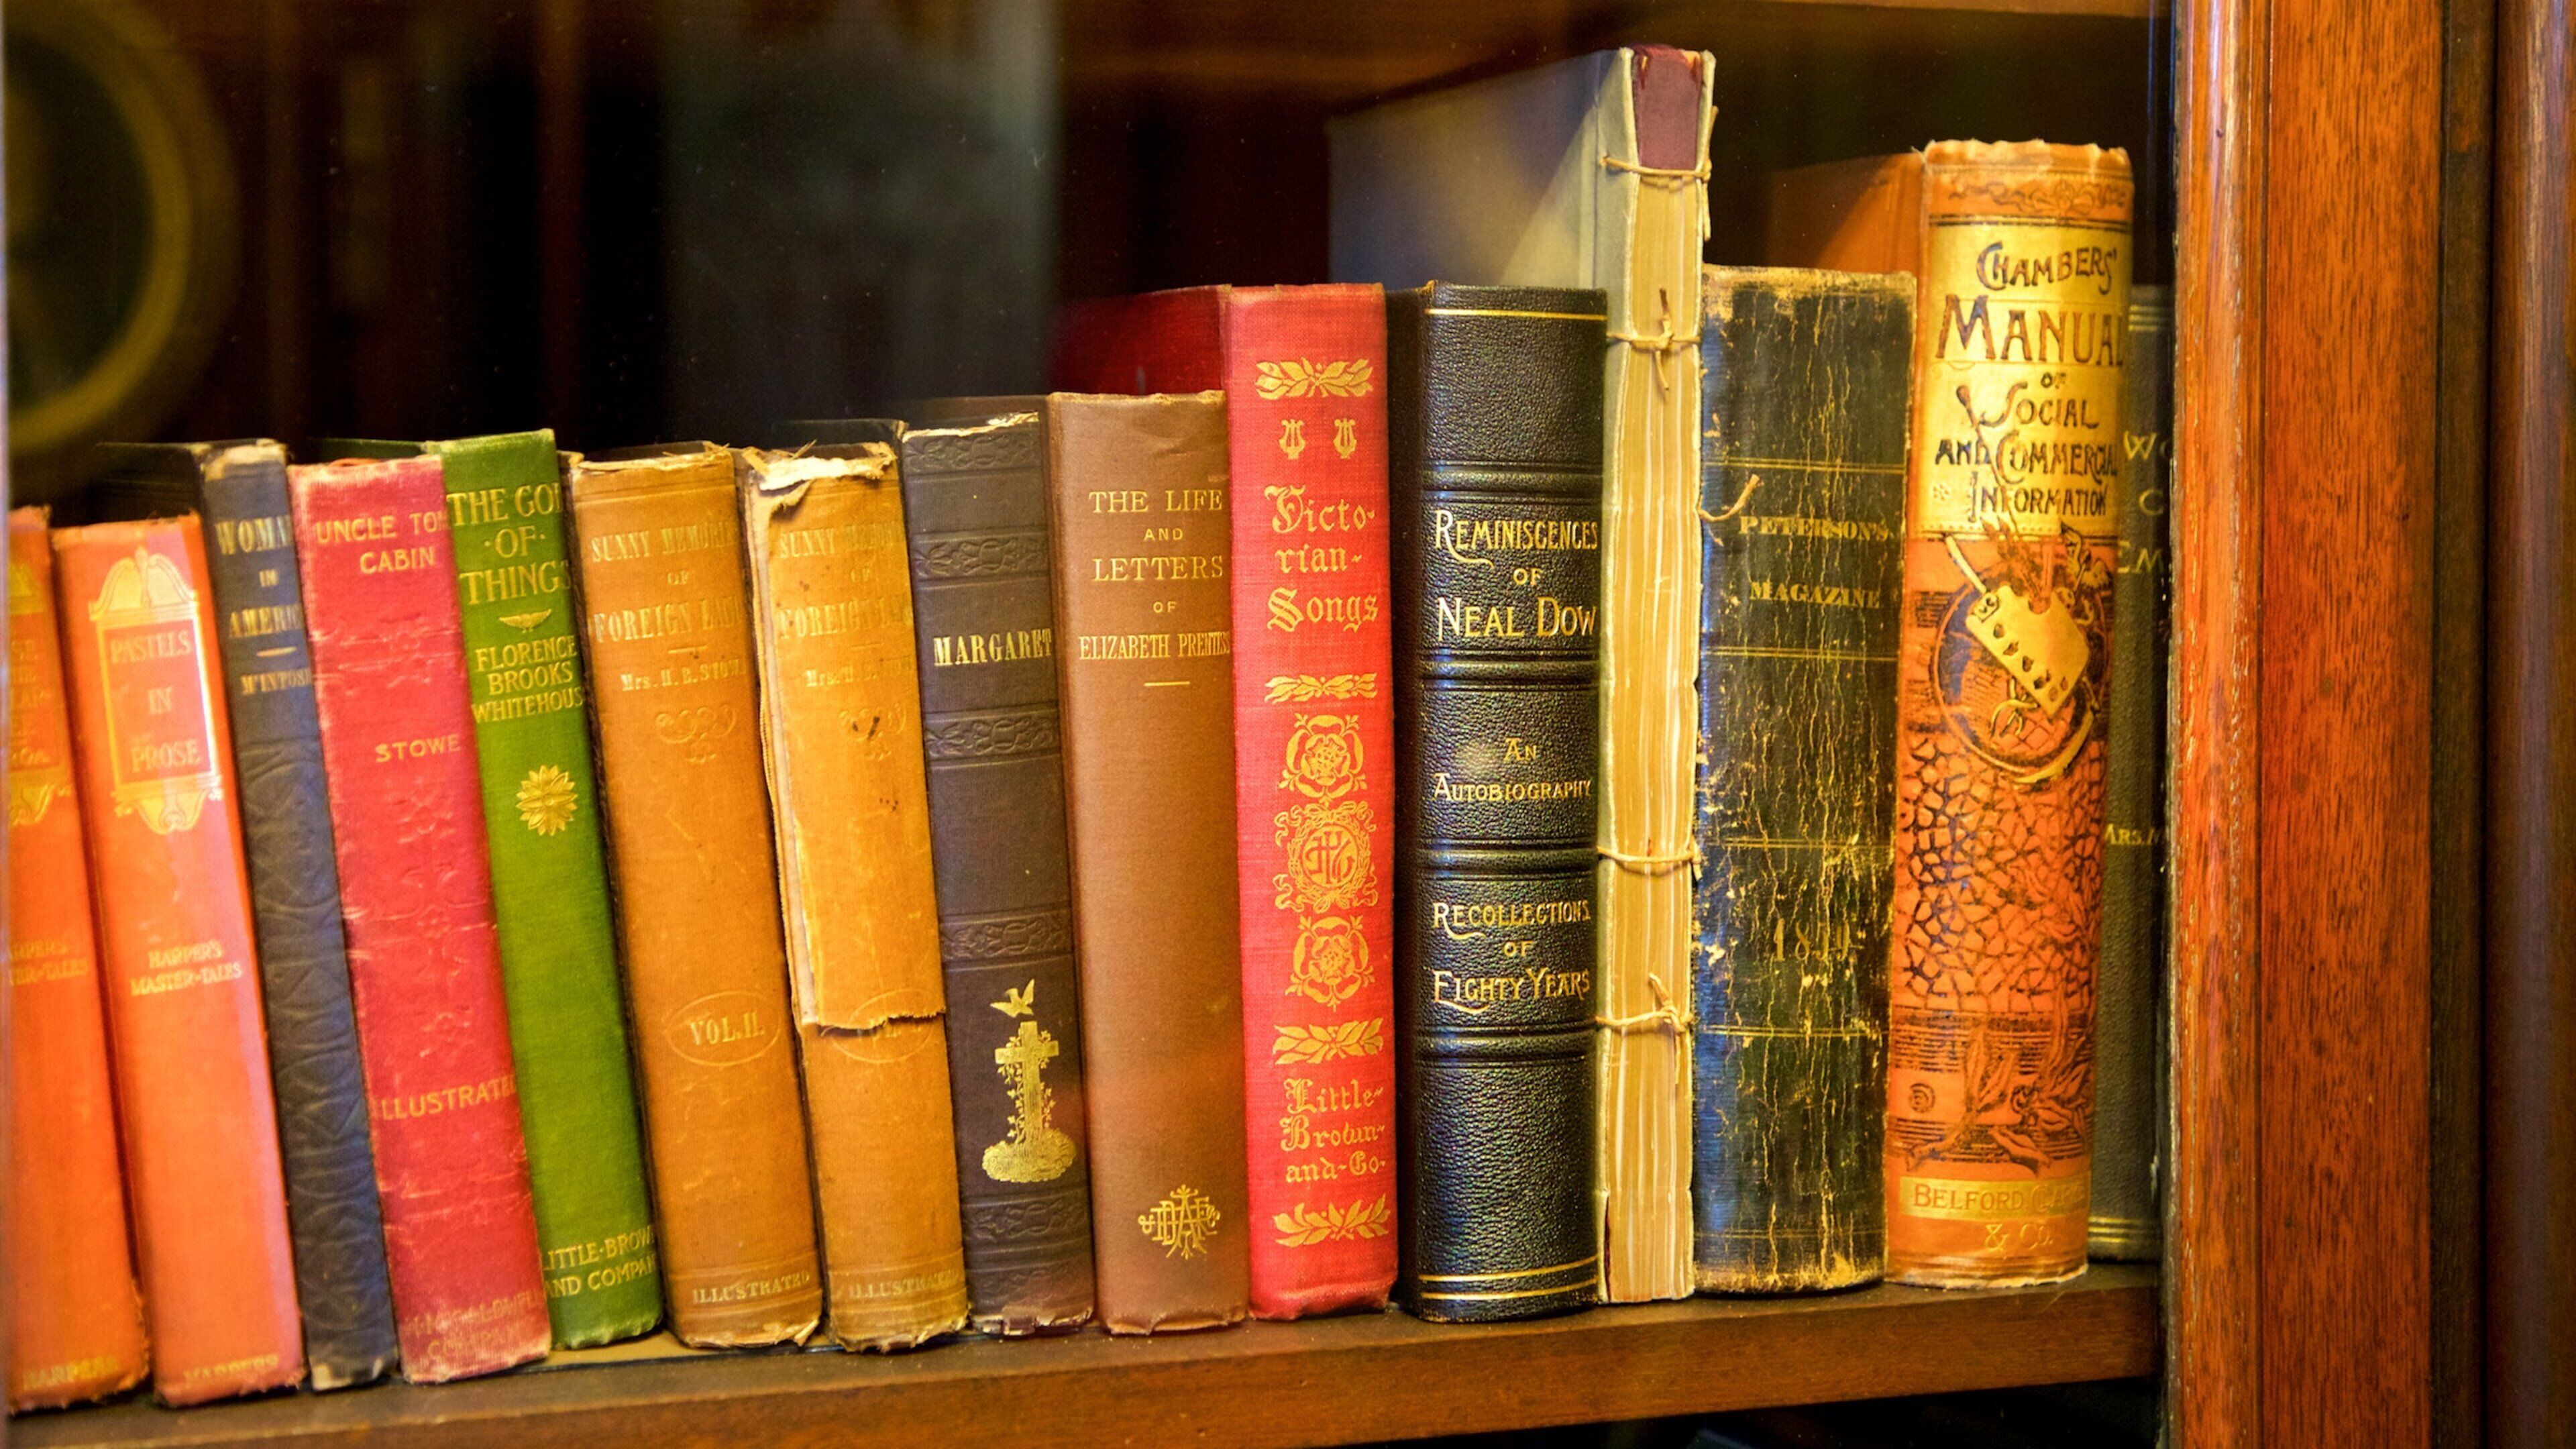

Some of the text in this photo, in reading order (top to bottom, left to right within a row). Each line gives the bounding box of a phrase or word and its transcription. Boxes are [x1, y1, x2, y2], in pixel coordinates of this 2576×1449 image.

[1976, 241, 2117, 295] CHAMBERS'
[1935, 294, 2124, 367] MANUAL
[2041, 372, 2066, 388] OF
[1978, 382, 2100, 429] SOCIAL
[1935, 439, 1991, 466] AND
[1996, 430, 2118, 484] COMMERCIAL
[446, 488, 508, 527] THE
[1088, 489, 1223, 514] THE LIFE
[1968, 472, 2108, 523] INFORMATION
[316, 515, 396, 544] UNCLE
[1143, 527, 1183, 542] AND
[1434, 508, 1599, 568] REMINISCENCES
[1739, 516, 1889, 541] PETERSON'S
[360, 546, 435, 574] CABIN
[591, 531, 651, 562] SUNNY
[667, 570, 690, 585] OF
[1093, 555, 1224, 582] LETTERS
[1513, 568, 1544, 586] OF
[1153, 601, 1177, 613] OF
[1267, 587, 1379, 633] Songs
[1750, 582, 1880, 608] MAGAZINE
[594, 602, 692, 643] FOREIGN
[1437, 596, 1597, 641] NEAL DOW
[110, 631, 191, 665] PASTELS
[476, 634, 578, 672] FLORENCE
[1078, 633, 1171, 660] ELIZABETH
[488, 661, 574, 696] BROOKS
[148, 686, 172, 716] IN
[472, 686, 584, 724] WHITEHOUS
[131, 739, 201, 773] PROSE
[376, 734, 461, 763] STOWE
[1503, 737, 1537, 762] AN
[1503, 941, 1535, 957] OF
[1432, 967, 1590, 1014] EIGHTY YEARS
[1984, 1223, 2008, 1252] &
[587, 1253, 656, 1291] COMPAN
